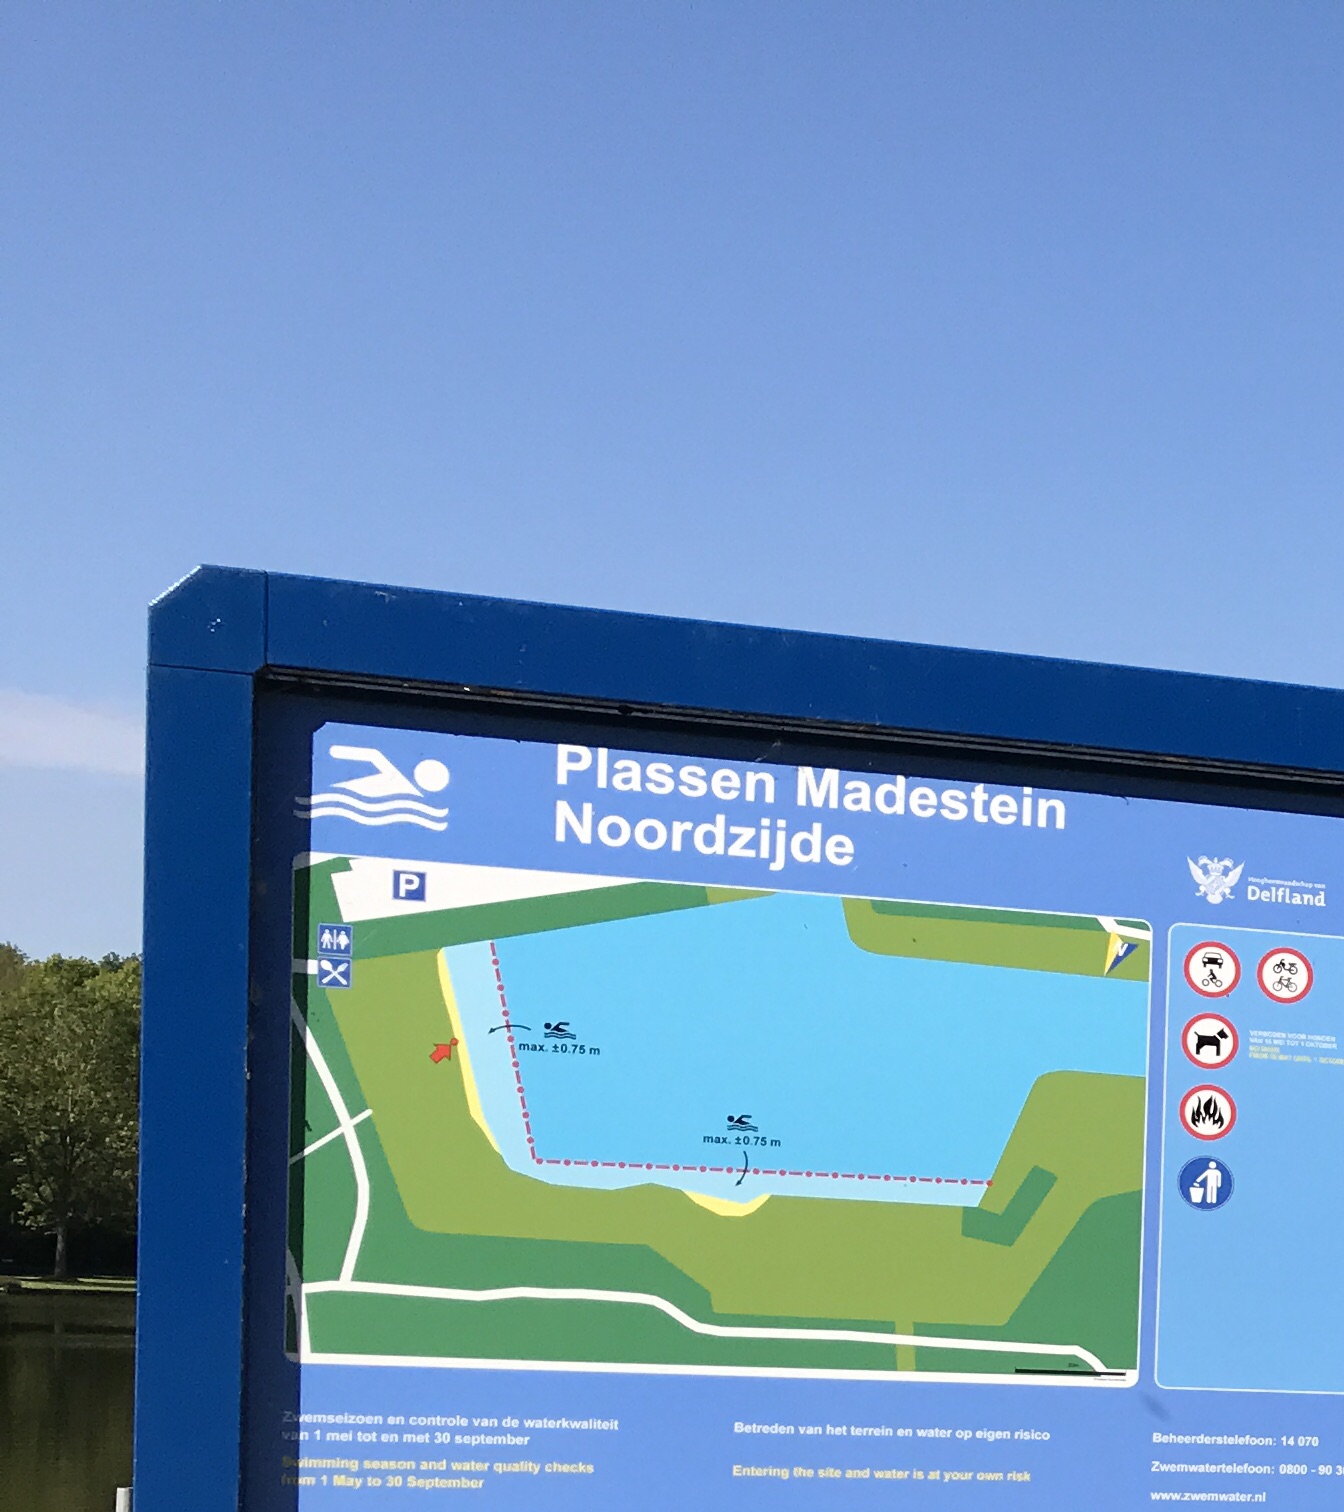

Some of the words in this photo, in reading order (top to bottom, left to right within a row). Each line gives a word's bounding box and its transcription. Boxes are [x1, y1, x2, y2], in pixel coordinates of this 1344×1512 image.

[556, 743, 774, 803] Plassen
[797, 766, 1065, 829] Madestein
[555, 799, 854, 871] Noordzijde
[399, 874, 420, 897] P
[1247, 885, 1326, 906] Delfland
[518, 1043, 548, 1052] max.
[551, 1043, 585, 1054] ±0.75
[589, 1047, 600, 1055] m
[703, 1135, 731, 1144] max.
[734, 1135, 767, 1146] ±0.75
[770, 1139, 781, 1147] m
[387, 1415, 405, 1425] en
[408, 1414, 468, 1426] controle
[472, 1418, 498, 1427] van
[501, 1416, 519, 1428] de
[523, 1417, 618, 1430] waterkwaliteit
[314, 1429, 320, 1440] 1
[326, 1430, 352, 1441] mei
[356, 1430, 377, 1442] tot
[380, 1433, 398, 1442] en
[402, 1432, 430, 1443] met
[434, 1431, 450, 1444] 30
[454, 1433, 530, 1446] september
[733, 1421, 794, 1434] Betreden
[798, 1425, 822, 1434] van
[825, 1424, 847, 1435] het
[850, 1425, 893, 1436] terrein
[896, 1428, 913, 1437] en
[916, 1427, 952, 1438] water
[955, 1429, 972, 1440] op
[975, 1428, 1010, 1441] eigen
[1014, 1428, 1050, 1440] risico
[1152, 1432, 1276, 1445] Beheerderstelefoon:
[1281, 1435, 1294, 1446] 14
[1297, 1435, 1319, 1446] 070
[363, 1459, 416, 1470] season
[419, 1458, 446, 1470] and
[450, 1460, 490, 1472] water
[493, 1460, 540, 1475] quality
[544, 1461, 594, 1473] checks
[732, 1465, 789, 1479] Entering
[792, 1466, 814, 1478] the
[817, 1466, 842, 1478] site
[844, 1467, 870, 1478] and
[873, 1468, 910, 1479] water
[912, 1468, 924, 1479] is
[927, 1469, 940, 1480] at
[943, 1471, 973, 1482] your
[976, 1471, 1003, 1481] own
[1006, 1470, 1030, 1481] risk
[1150, 1460, 1274, 1474] Zwemwatertelefoon:
[1279, 1463, 1307, 1475] 0800
[1318, 1464, 1332, 1475] 90
[320, 1474, 327, 1485] 1
[332, 1474, 363, 1489] May
[366, 1476, 382, 1486] to
[385, 1475, 402, 1487] 30
[406, 1475, 484, 1490] September
[1150, 1491, 1266, 1502] www.zwemwater.nl
